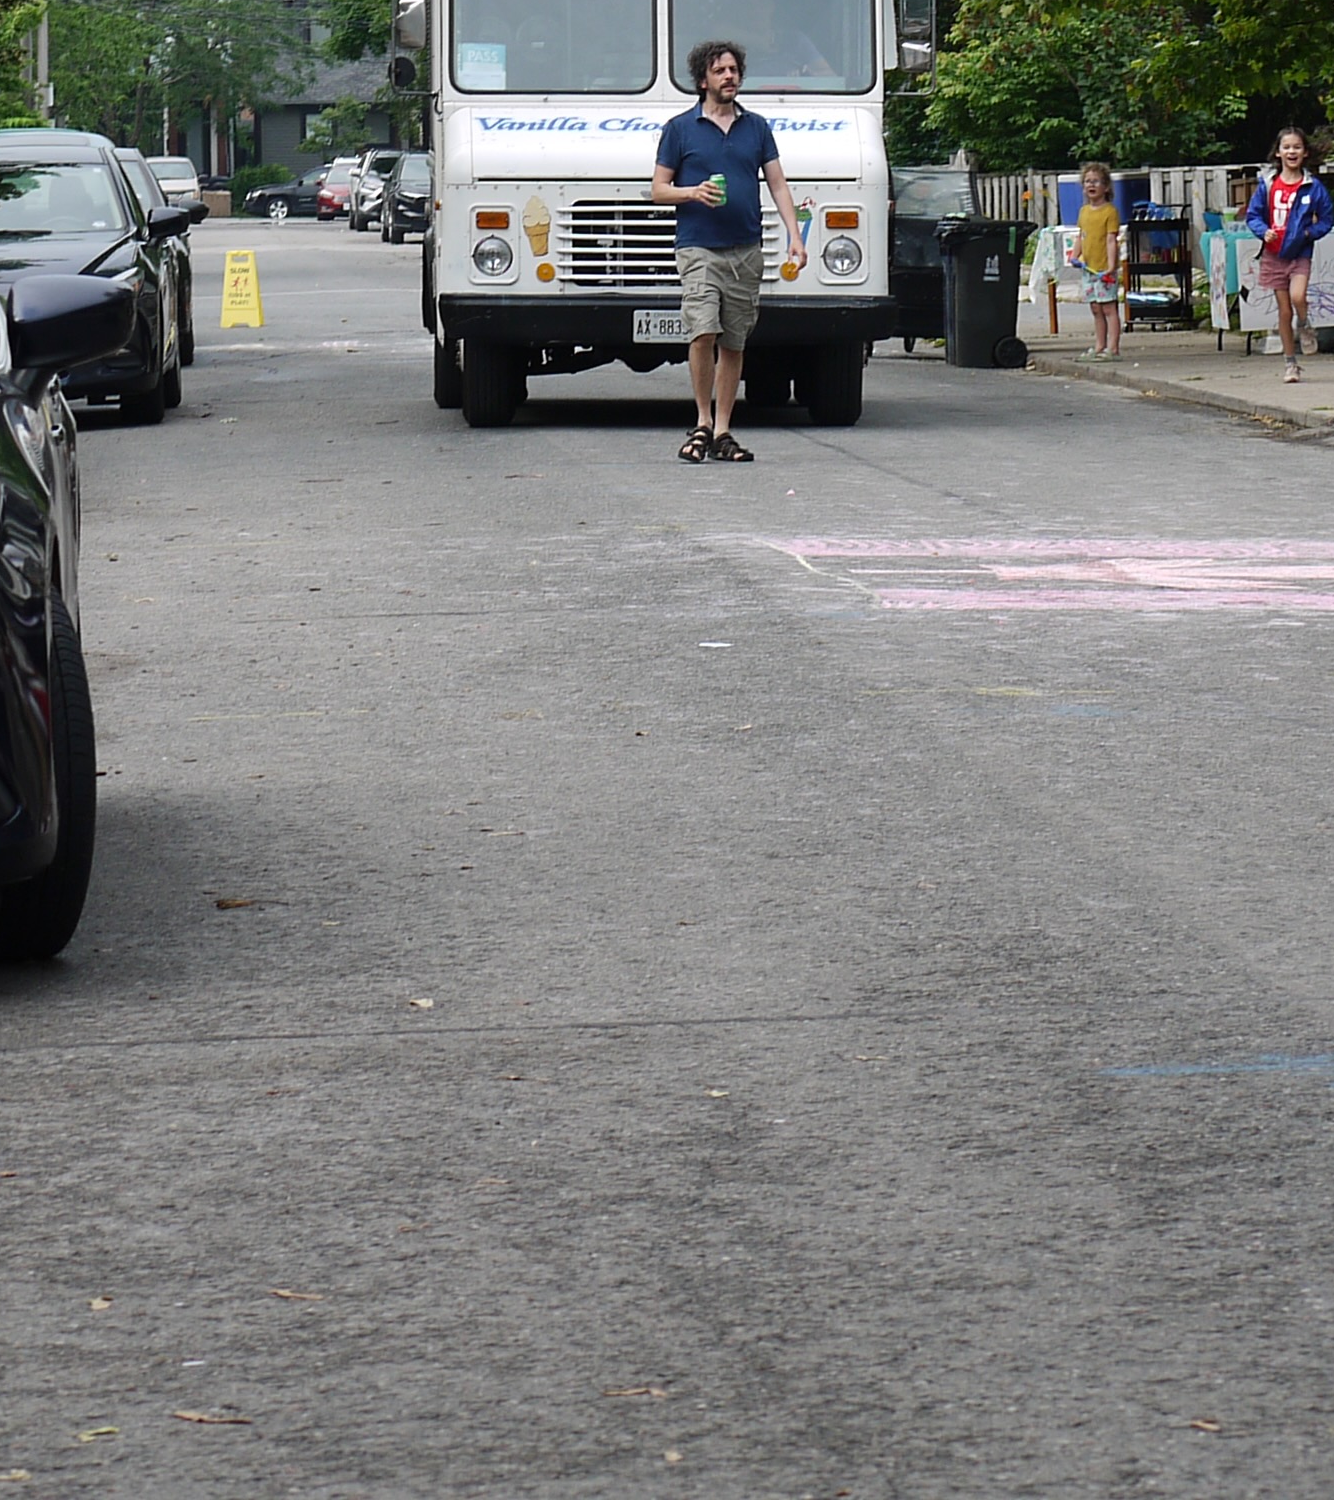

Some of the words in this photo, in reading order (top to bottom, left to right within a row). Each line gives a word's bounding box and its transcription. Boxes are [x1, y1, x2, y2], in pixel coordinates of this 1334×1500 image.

[468, 49, 499, 62] PASS
[474, 116, 579, 131] Vanilla
[598, 116, 667, 132] Cho
[768, 117, 852, 132] Twist
